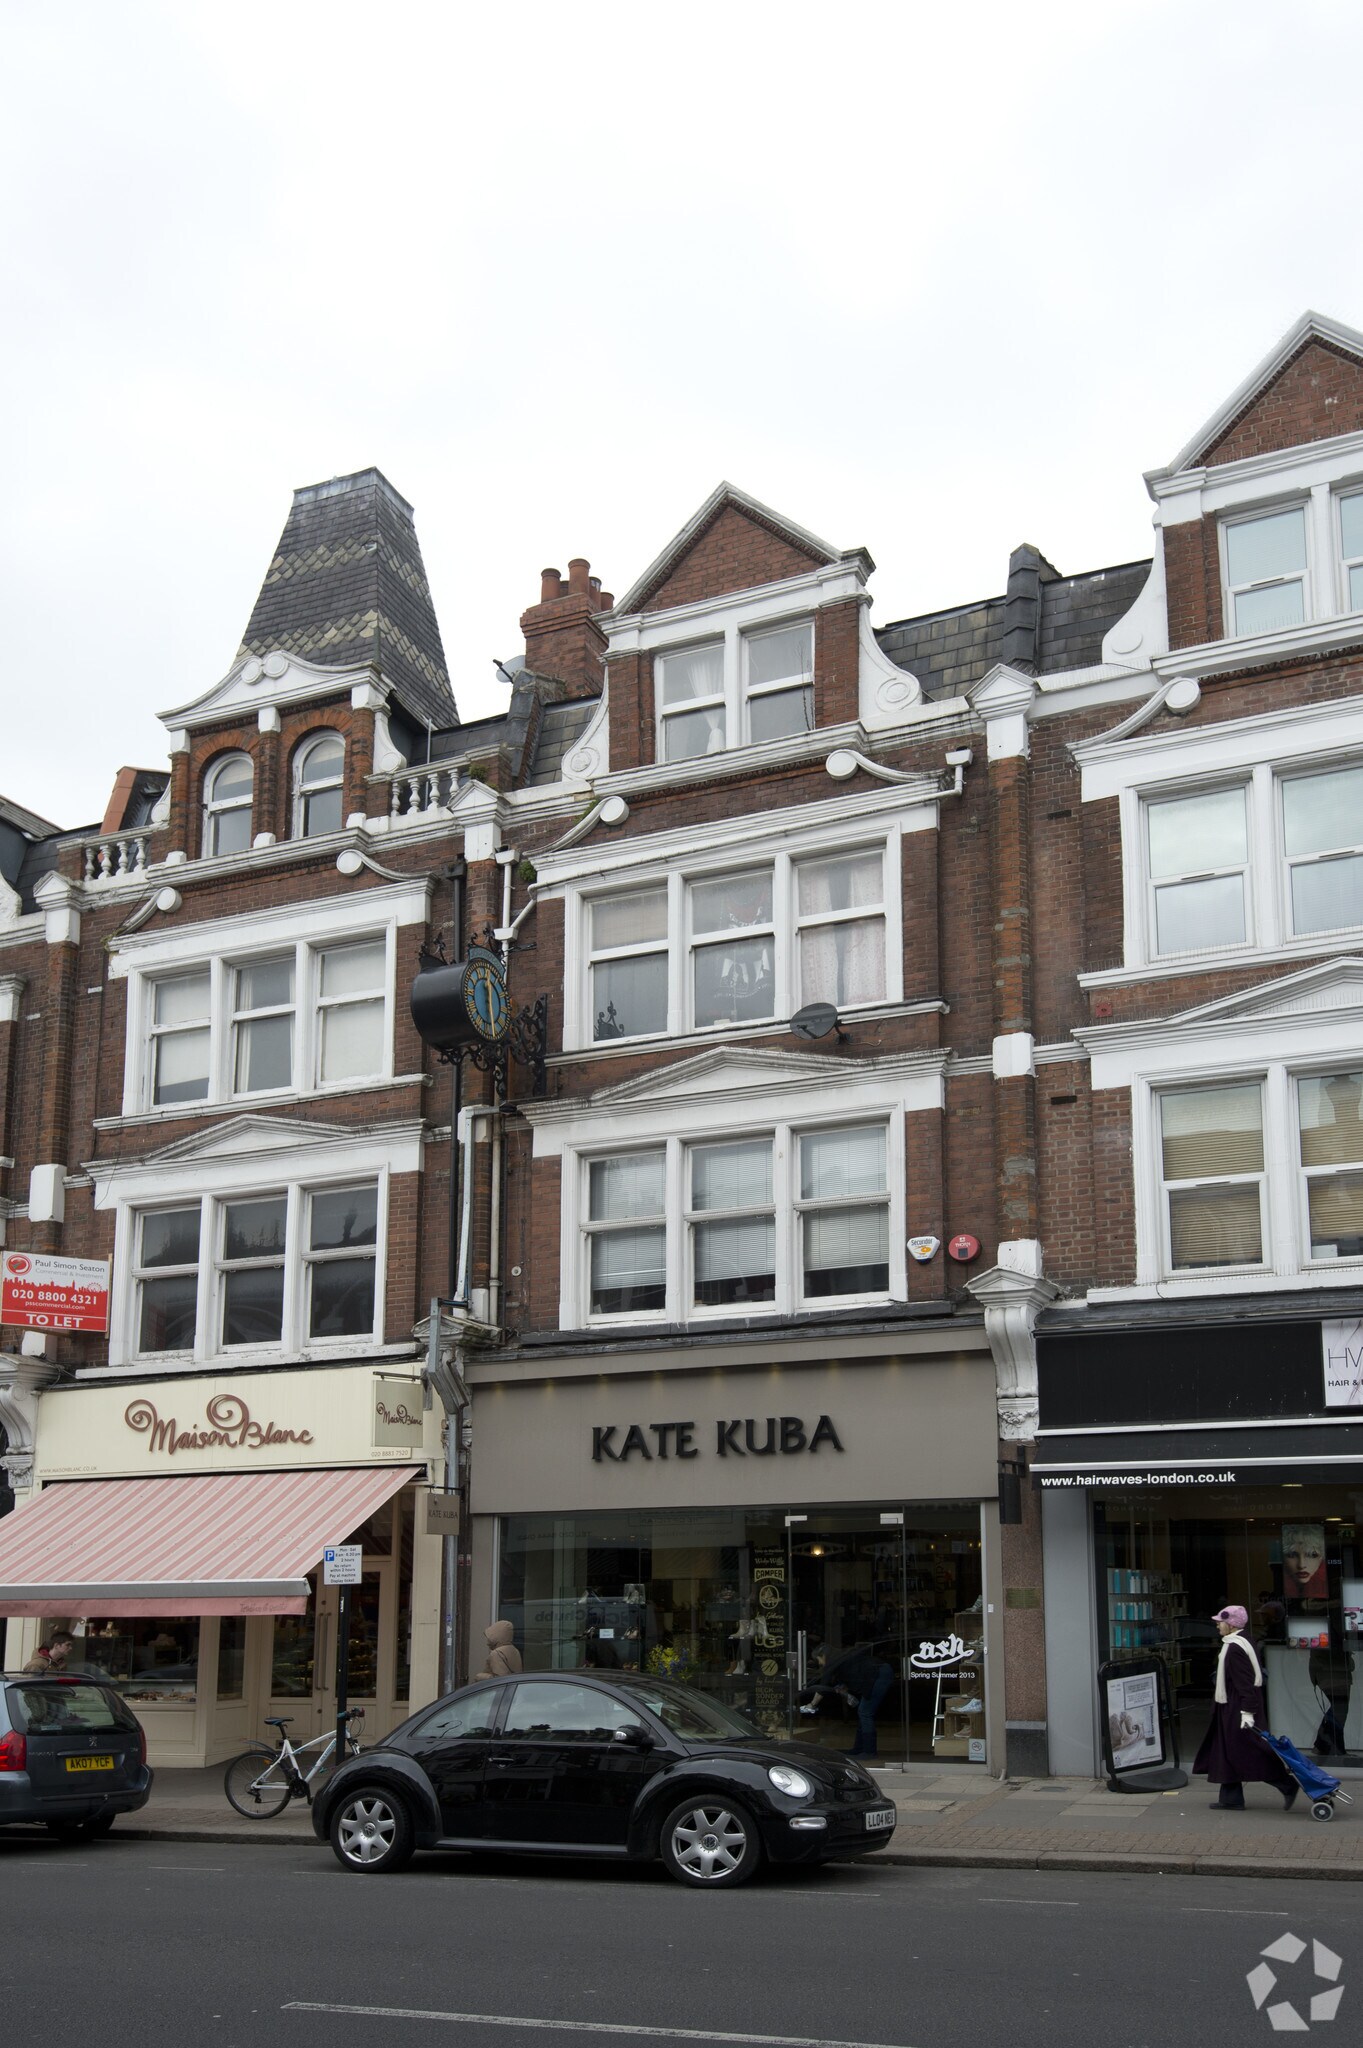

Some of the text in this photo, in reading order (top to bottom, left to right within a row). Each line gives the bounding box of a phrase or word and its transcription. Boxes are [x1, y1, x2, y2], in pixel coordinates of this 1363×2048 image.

[35, 1259, 105, 1273] Paul Simon Seaton
[35, 1268, 69, 1276] Commercial
[12, 1289, 97, 1305] 020 8800 4321
[25, 1301, 85, 1310] psscommercial.com
[26, 1313, 83, 1328] TO LET
[376, 1402, 423, 1426] Maison Blanc
[125, 1394, 314, 1455] Maison Blanc
[591, 1415, 846, 1462] KATE KUBA
[1041, 1471, 1236, 1486] www.hairwaves-london.co.uk
[443, 1511, 458, 1519] KUBA
[755, 1569, 783, 1580] CAMPER
[755, 1634, 784, 1648] UGG
[911, 1633, 975, 1668] ash
[910, 1671, 931, 1680] Spring
[70, 1757, 111, 1769] AK07 YCF
[868, 1813, 884, 1828] LL04
